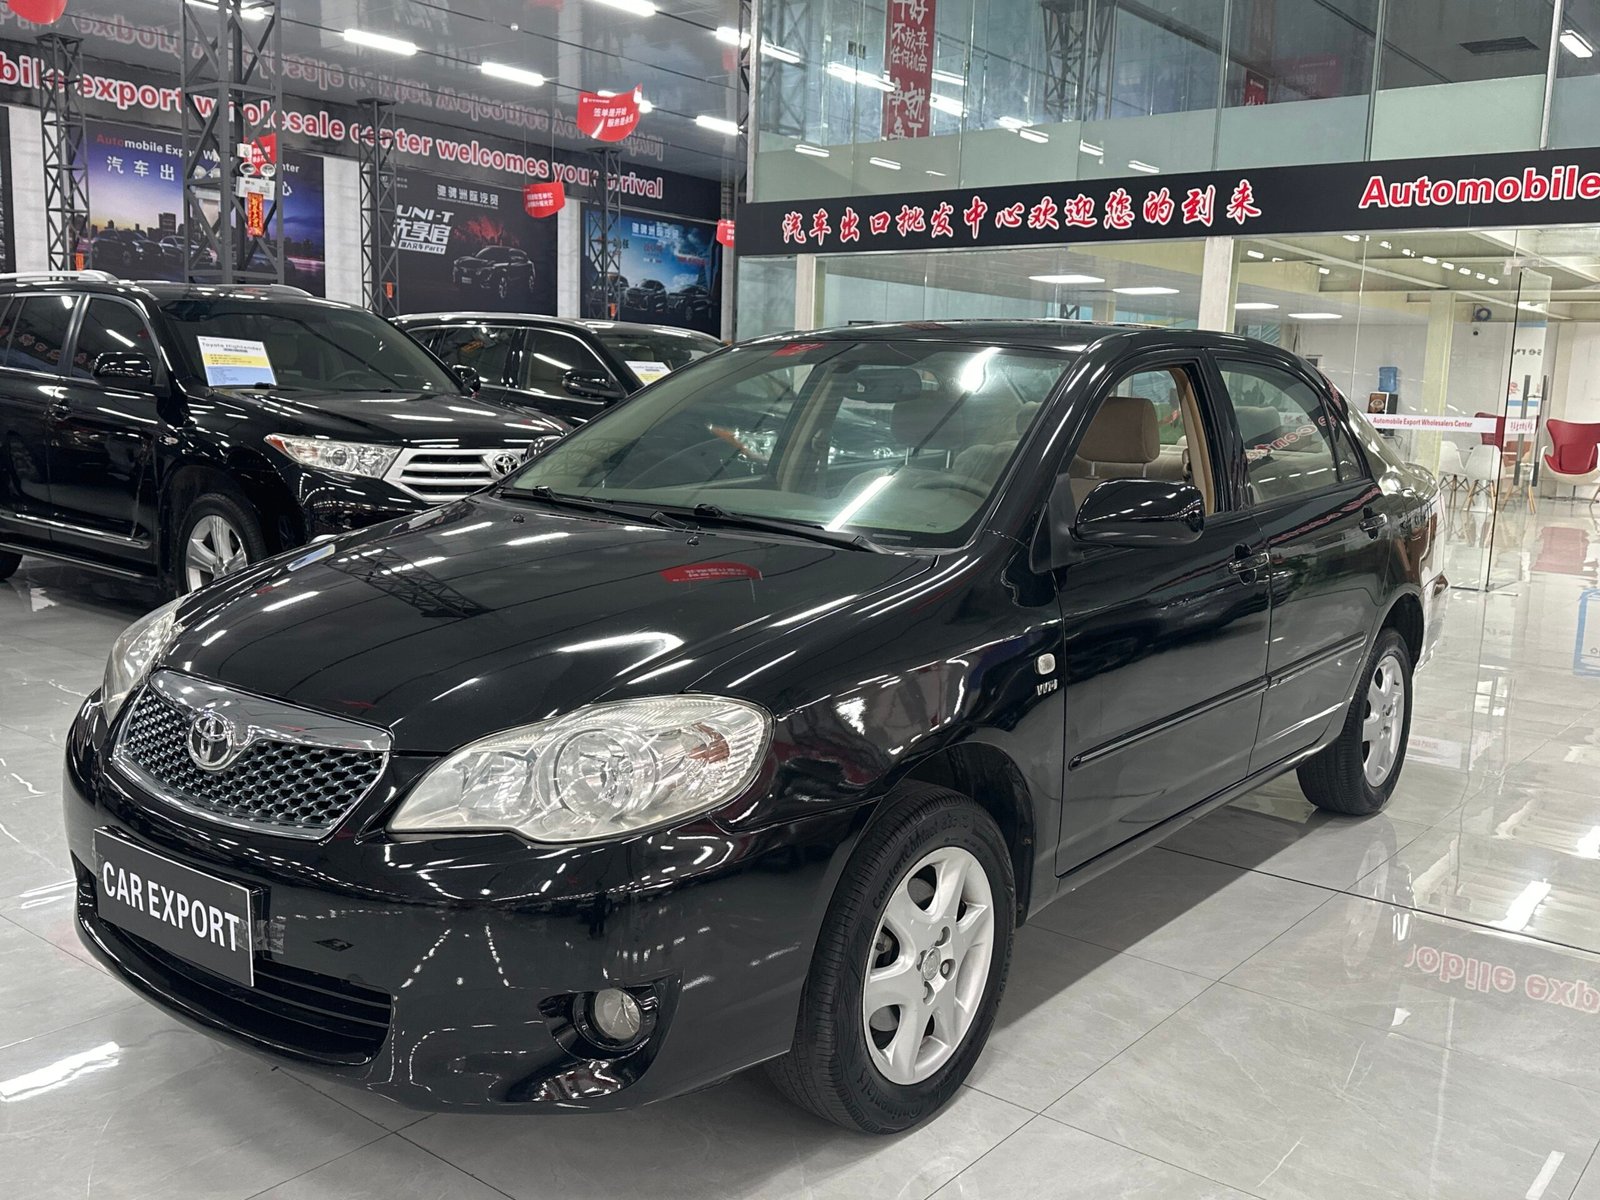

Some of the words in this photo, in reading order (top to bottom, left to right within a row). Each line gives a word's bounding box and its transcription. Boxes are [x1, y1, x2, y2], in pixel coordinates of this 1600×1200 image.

[96, 133, 164, 153] Automobile
[436, 139, 551, 178] welcomes
[106, 156, 175, 181] 汽车出
[1358, 165, 1600, 208] Automobile
[396, 204, 455, 223] UNI-T
[782, 179, 1262, 246] 汽车出口批发中心欢迎您的到来
[1373, 416, 1403, 425] Automobile
[1403, 418, 1421, 427] Export
[1421, 419, 1454, 427] Wholesalers
[1454, 420, 1473, 428] Center
[102, 861, 144, 912] CAR
[147, 880, 239, 952] EXPORT
